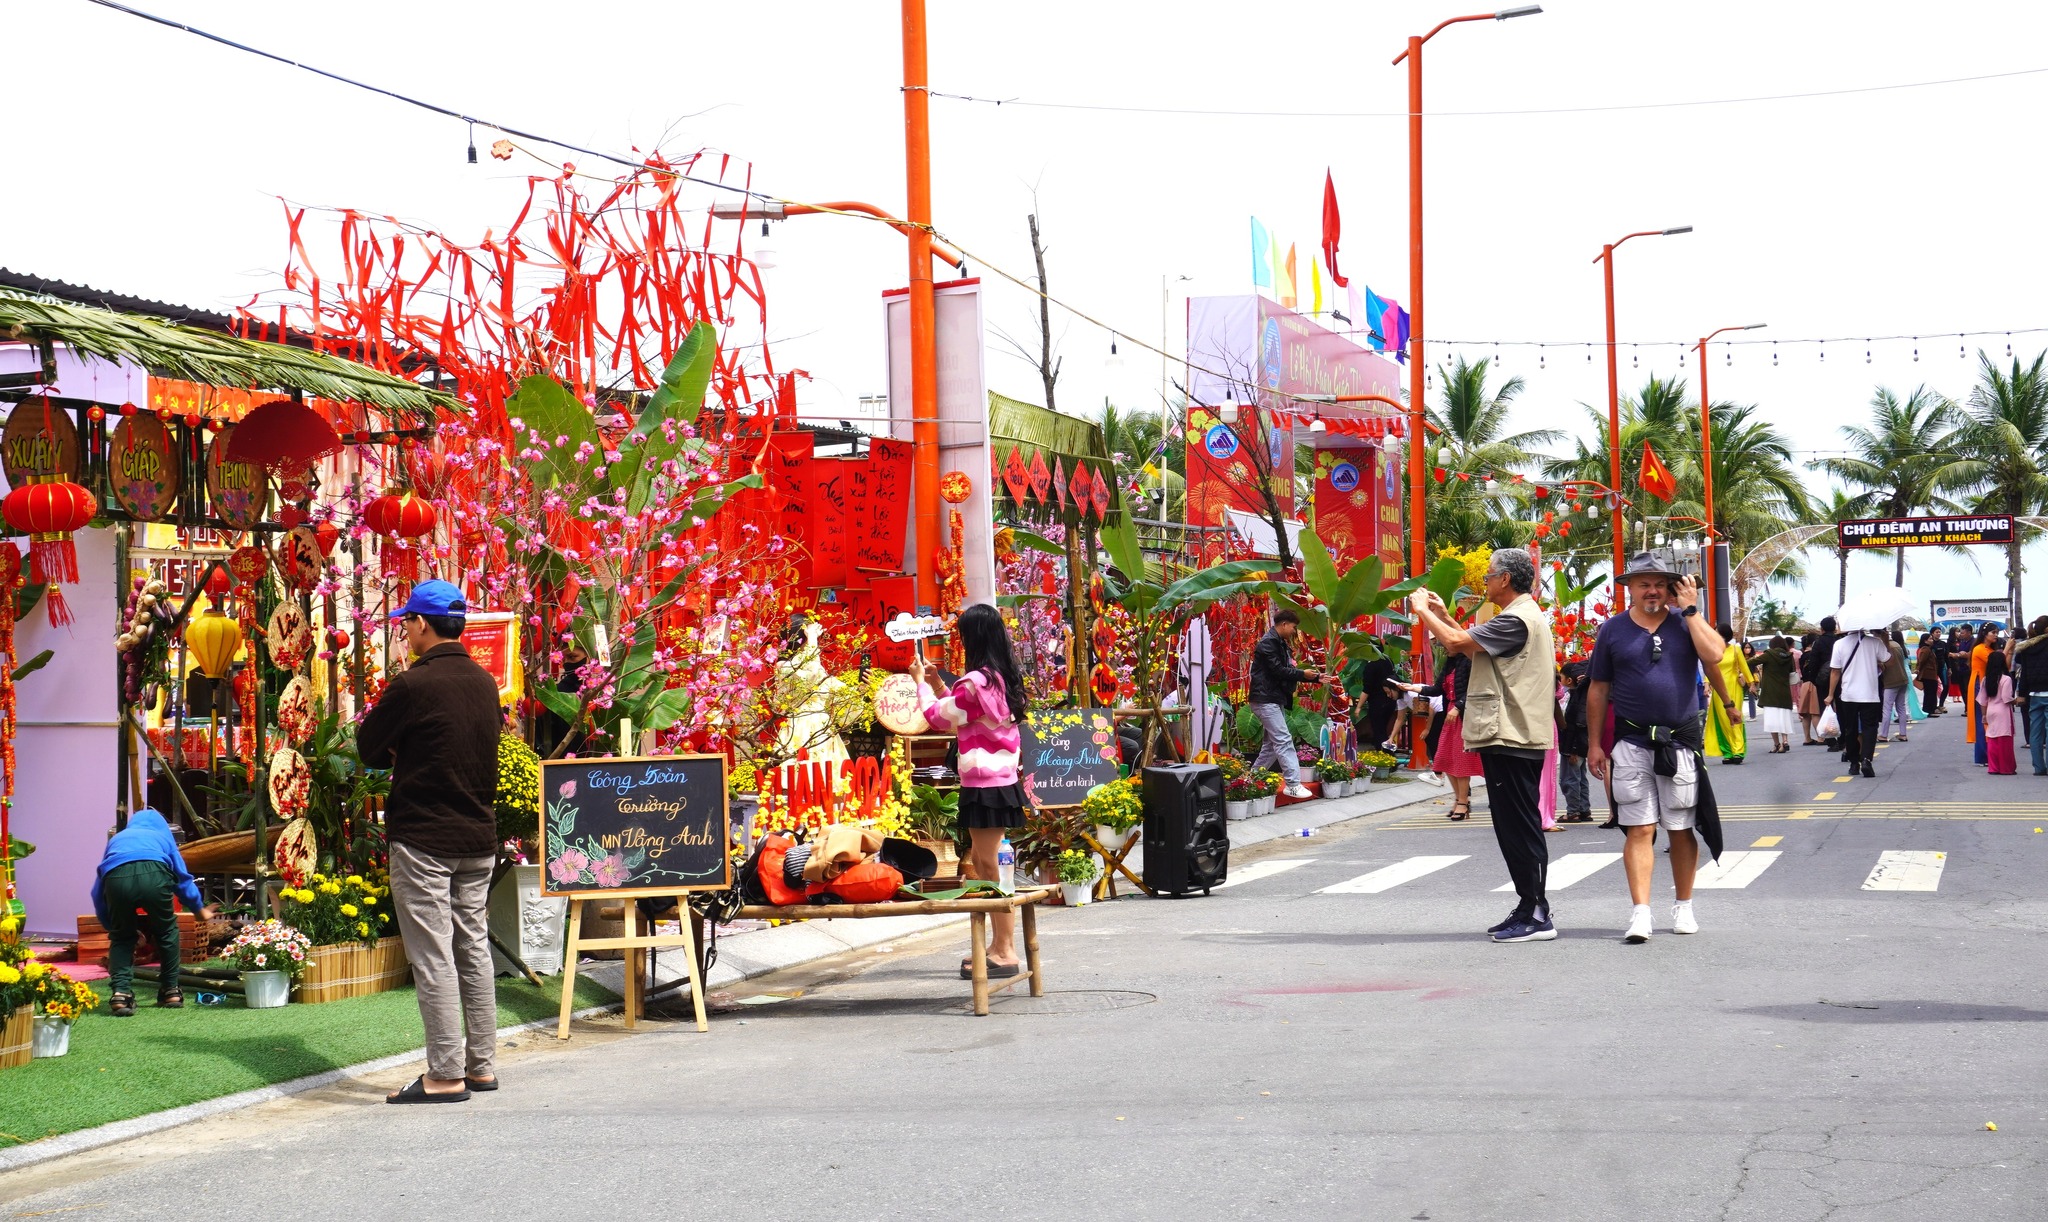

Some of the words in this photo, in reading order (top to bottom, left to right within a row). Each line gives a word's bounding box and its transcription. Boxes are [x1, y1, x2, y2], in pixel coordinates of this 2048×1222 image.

[1381, 504, 1399, 524] CHÀO
[1843, 523, 1876, 537] CHỢ
[1879, 521, 1914, 535] ĐÊM
[1919, 521, 1942, 532] AN
[1946, 518, 2009, 532] THƯỢNG
[1861, 535, 1887, 545] KÍNH
[1890, 534, 1918, 544] CHÀO
[1921, 533, 1942, 544] QUÝ
[1945, 533, 1981, 542] KHÁCH
[1947, 606, 1960, 614] SURF
[1961, 606, 1982, 614] LESSON
[1988, 605, 2008, 613] RENTAL
[587, 769, 637, 795] Công
[1033, 780, 1047, 788] vui
[1050, 776, 1064, 787] tết
[1077, 774, 1096, 786] lành
[602, 833, 621, 849] MN
[670, 818, 716, 846] Anh
